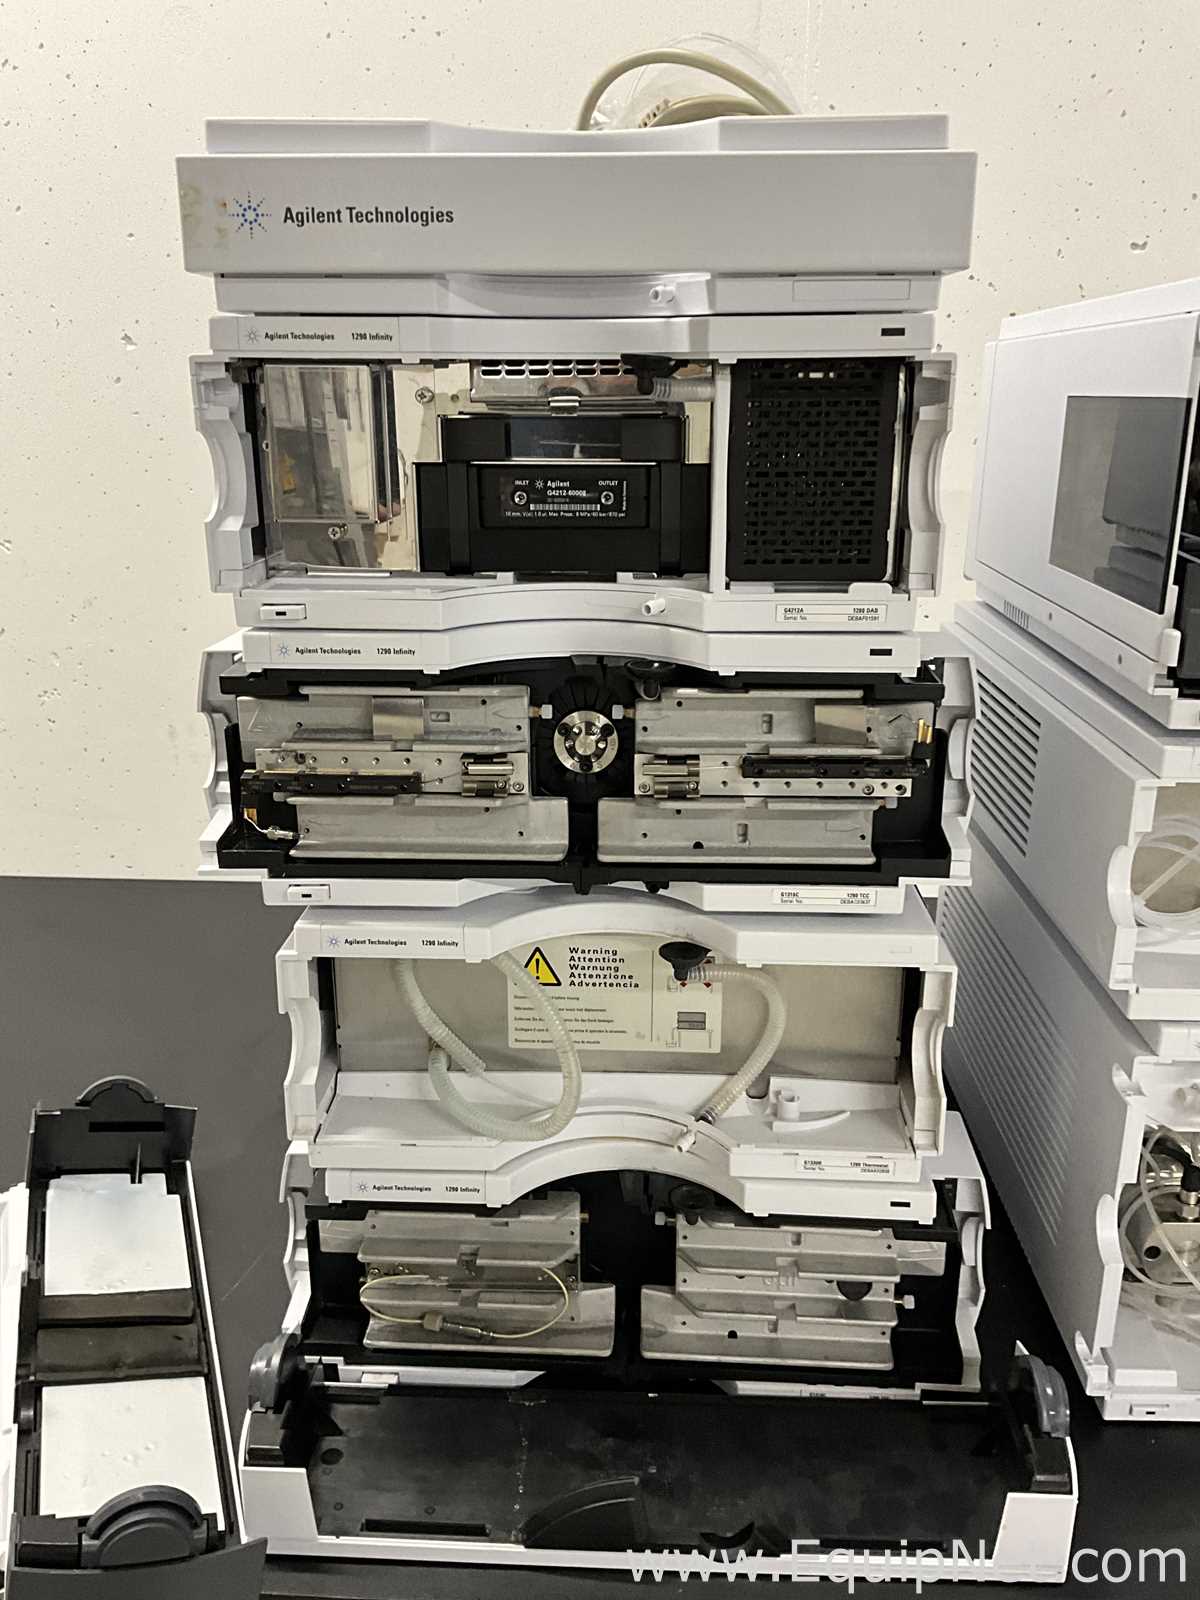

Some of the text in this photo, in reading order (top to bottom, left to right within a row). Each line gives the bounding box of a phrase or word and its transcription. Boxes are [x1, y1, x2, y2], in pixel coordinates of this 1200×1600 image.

[283, 206, 455, 228] Agilent Technologies
[264, 331, 393, 342] Agilent Technologies 1290 Infinity
[547, 480, 570, 488] Agilent
[295, 647, 319, 656] Agilent
[320, 647, 361, 656] Technologies
[393, 648, 416, 656] Infinity
[368, 939, 407, 947] Technologies
[437, 940, 459, 948] Infinity
[568, 946, 618, 957] Warning
[568, 955, 625, 964] Attention
[568, 963, 620, 973] Warnung
[568, 972, 634, 980] Attenzione
[568, 980, 640, 988] Advertencia
[372, 1184, 394, 1192] Agilent
[394, 1184, 432, 1193] Technologies
[460, 1186, 481, 1194] Infinity
